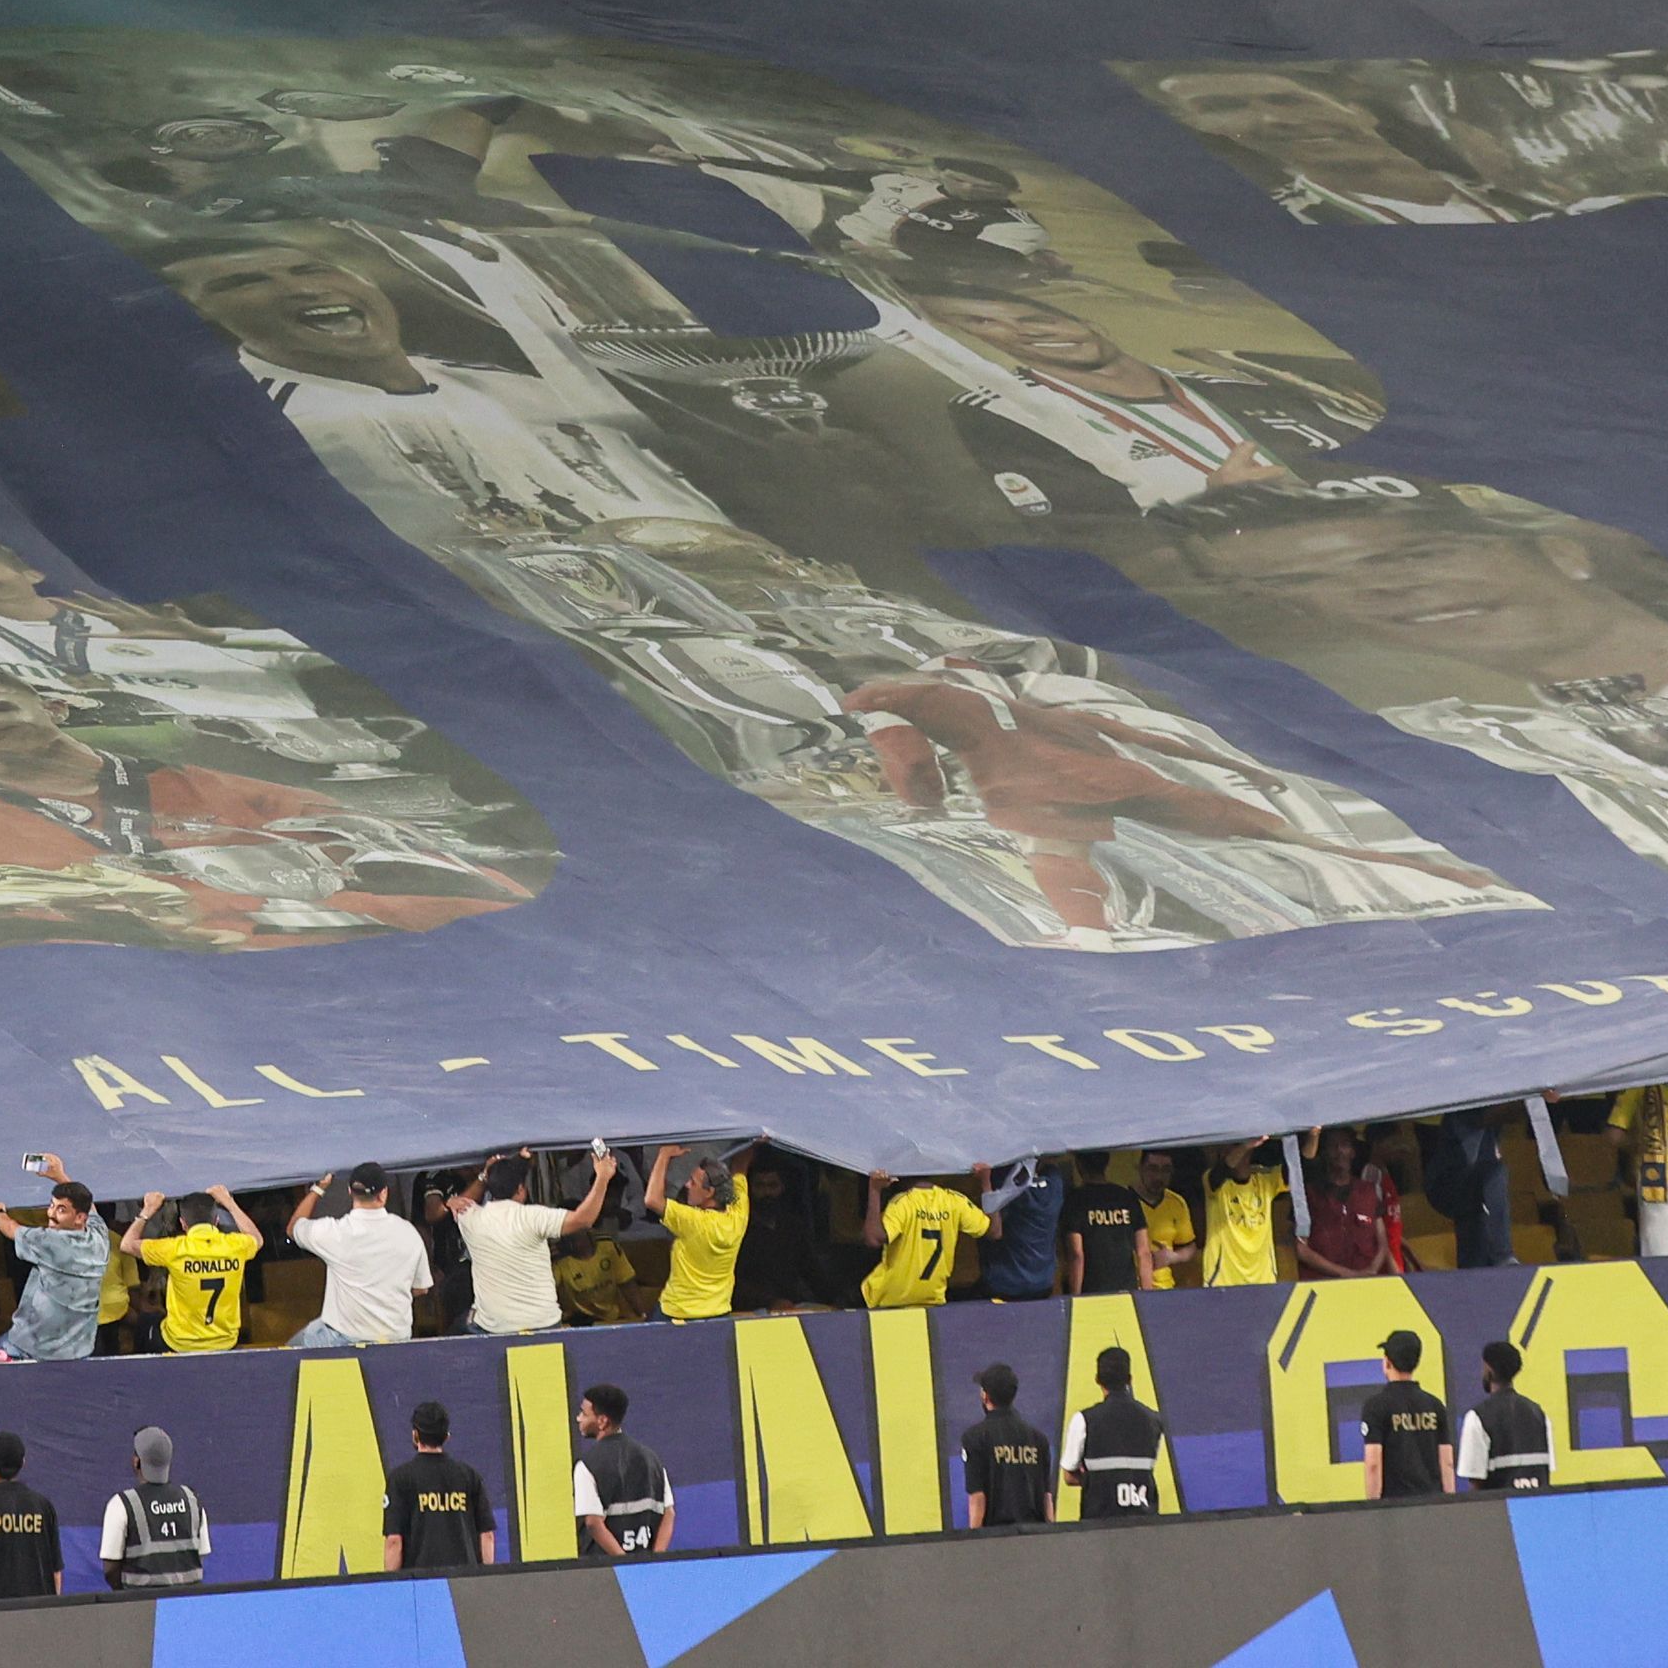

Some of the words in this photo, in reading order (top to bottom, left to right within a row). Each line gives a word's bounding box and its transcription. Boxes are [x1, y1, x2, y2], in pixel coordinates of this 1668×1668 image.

[73, 1054, 364, 1109] ALL
[561, 1033, 969, 1078] TIME
[1002, 1024, 1277, 1071] TOP
[1088, 1209, 1131, 1226] POLICE
[919, 1229, 943, 1281] 7
[184, 1258, 239, 1274] RONALDO
[200, 1278, 225, 1326] 7
[1392, 1412, 1437, 1432] POLICE
[993, 1445, 1038, 1465] POLICE
[150, 1498, 187, 1515] Guard
[418, 1492, 467, 1513] POLICE
[160, 1522, 177, 1537] 41
